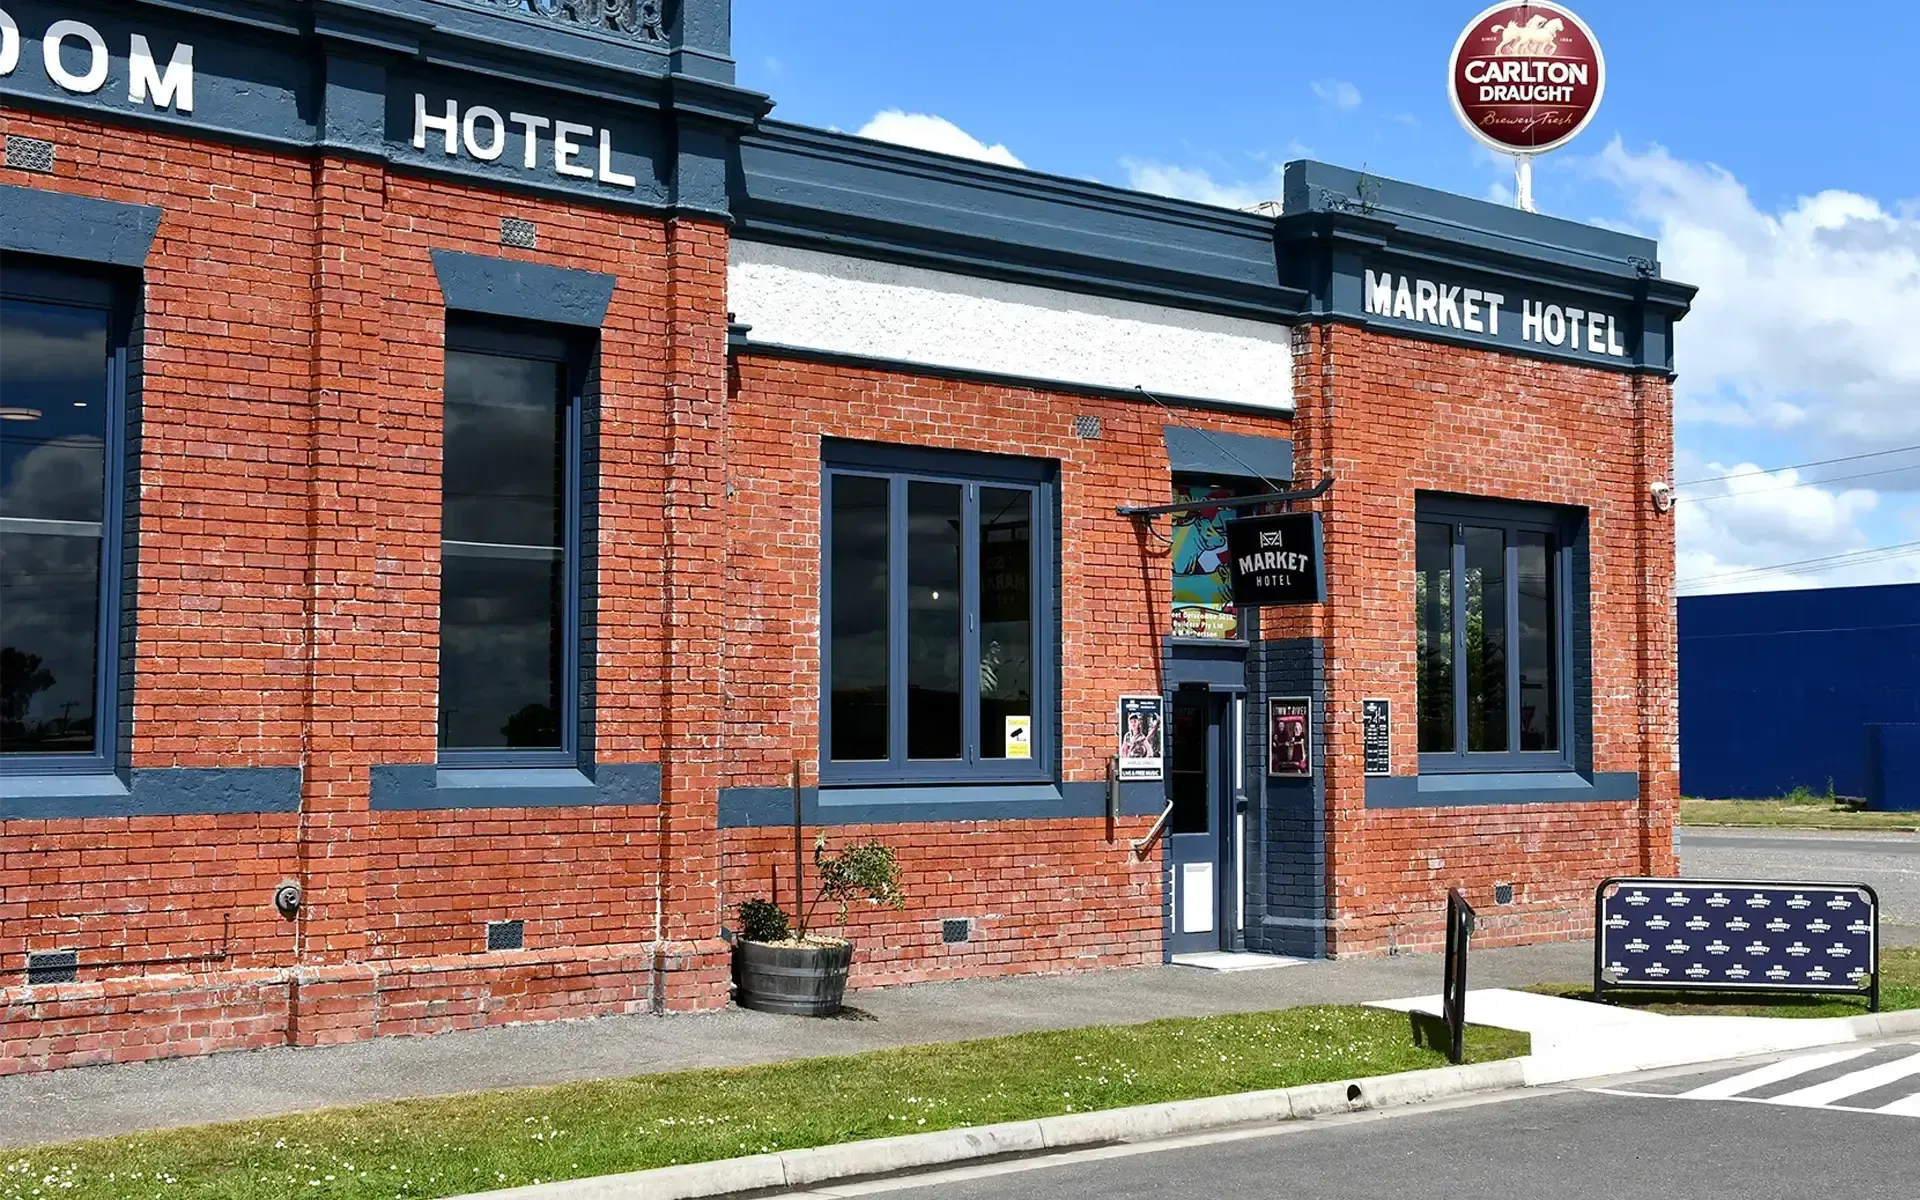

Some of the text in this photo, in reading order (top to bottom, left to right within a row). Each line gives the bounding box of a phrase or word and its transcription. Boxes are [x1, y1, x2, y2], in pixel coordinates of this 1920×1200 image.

[1464, 60, 1588, 84] CARLTON
[1480, 85, 1574, 102] DRAUGHT
[1480, 110, 1572, 132] Brewery Fresh
[413, 92, 636, 187] HOTEL
[1365, 269, 1624, 356] MARKET HOTEL
[1238, 552, 1308, 575] MARKET
[1256, 575, 1291, 586] HOTEL
